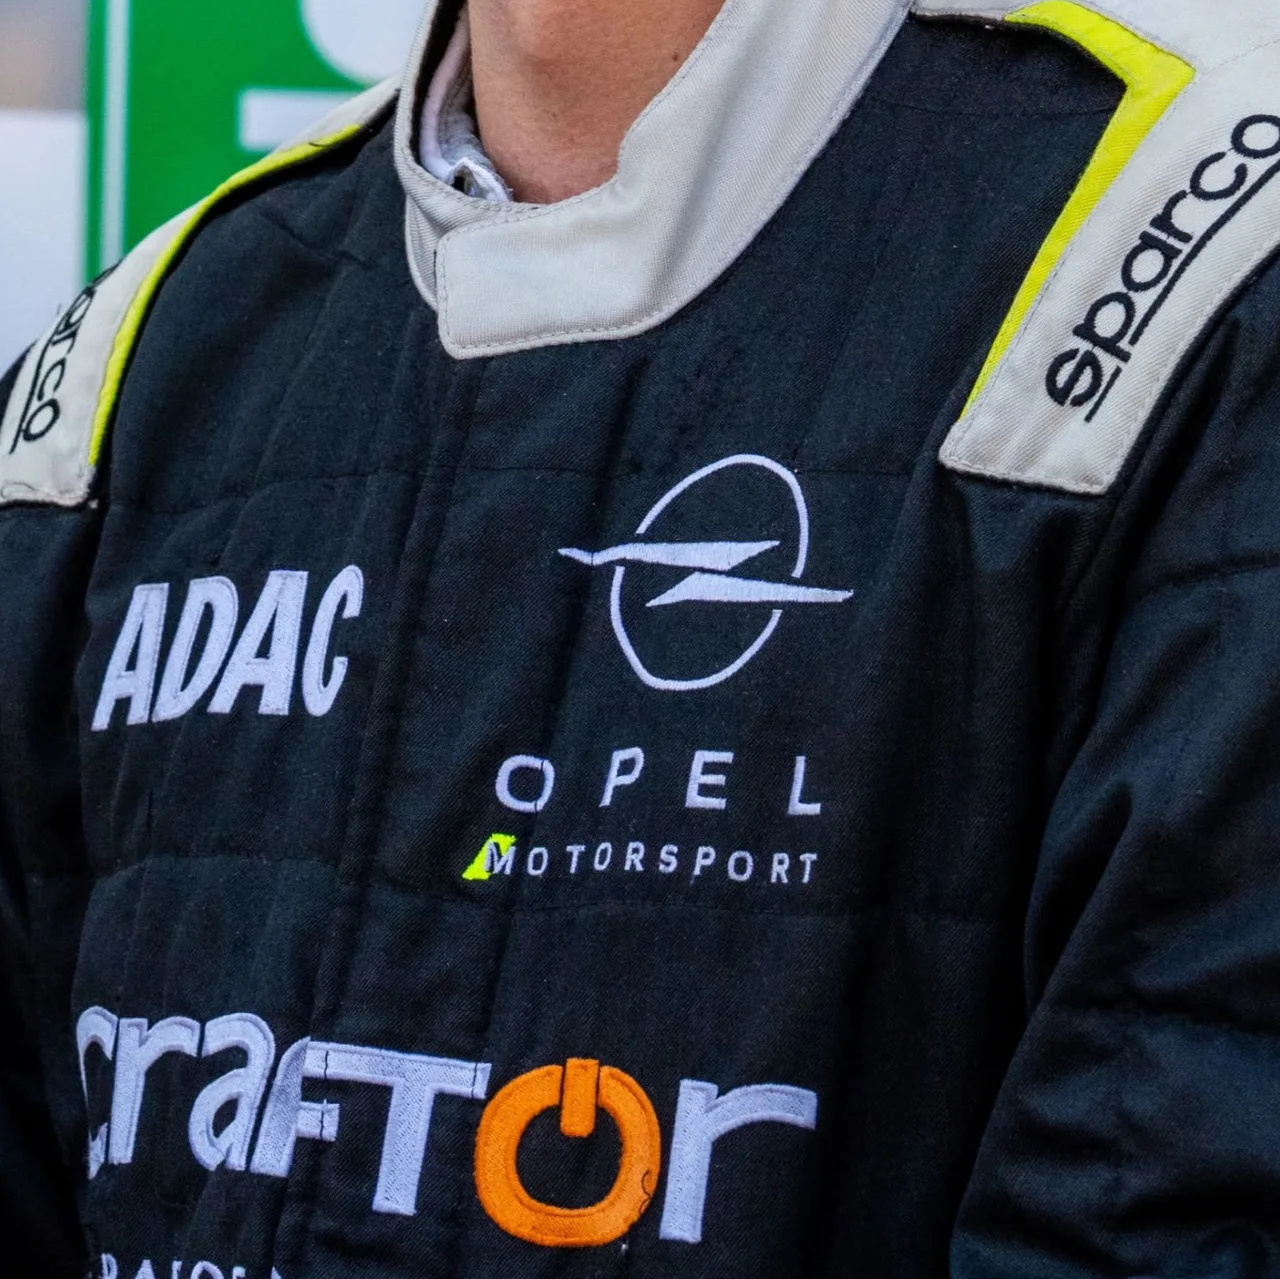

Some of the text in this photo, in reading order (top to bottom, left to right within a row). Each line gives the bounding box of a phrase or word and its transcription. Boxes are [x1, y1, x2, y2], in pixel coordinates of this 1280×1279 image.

[90, 564, 364, 733] ADAC
[494, 747, 823, 818] OPEL
[482, 828, 820, 886] MOTORSPORT
